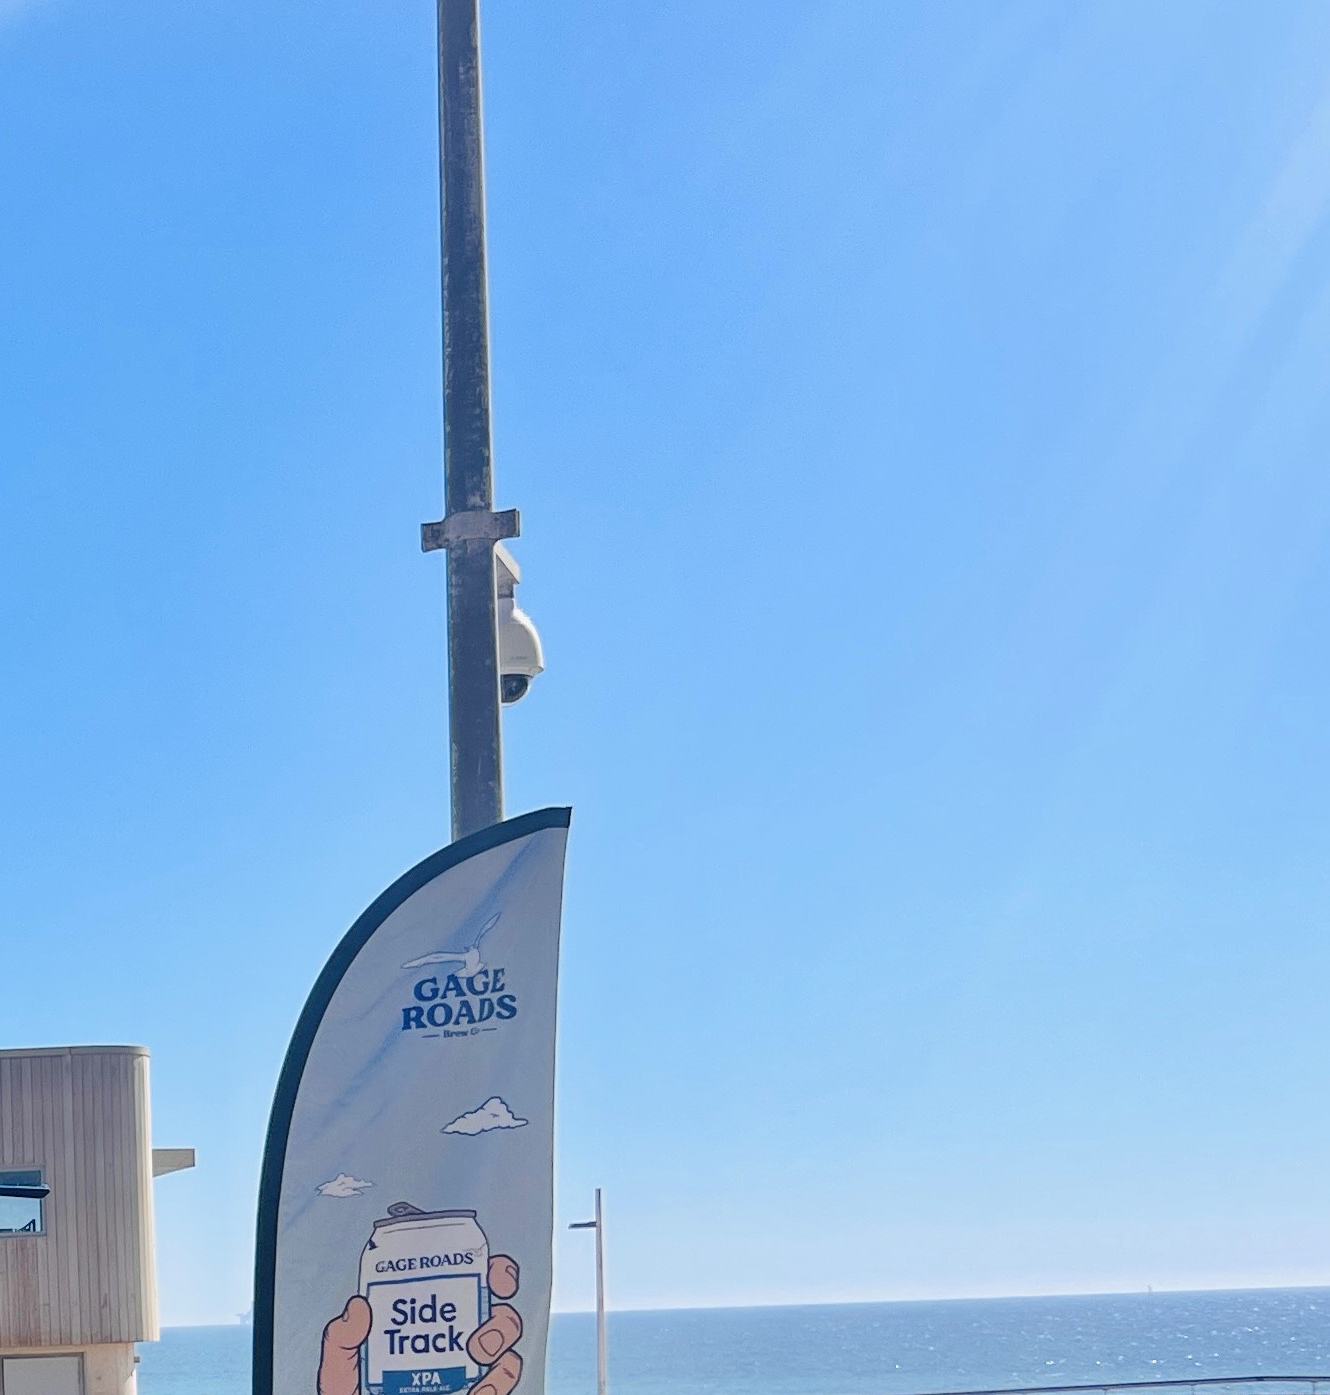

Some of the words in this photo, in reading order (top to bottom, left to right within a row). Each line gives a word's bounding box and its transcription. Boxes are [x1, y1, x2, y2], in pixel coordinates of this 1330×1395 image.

[413, 967, 506, 1002] GAGE
[401, 994, 518, 1031] ROADS
[375, 1257, 417, 1274] GAGE
[419, 1251, 474, 1269] ROADS
[390, 1293, 457, 1326] Side
[383, 1324, 465, 1355] Track
[411, 1371, 442, 1385] XPA
